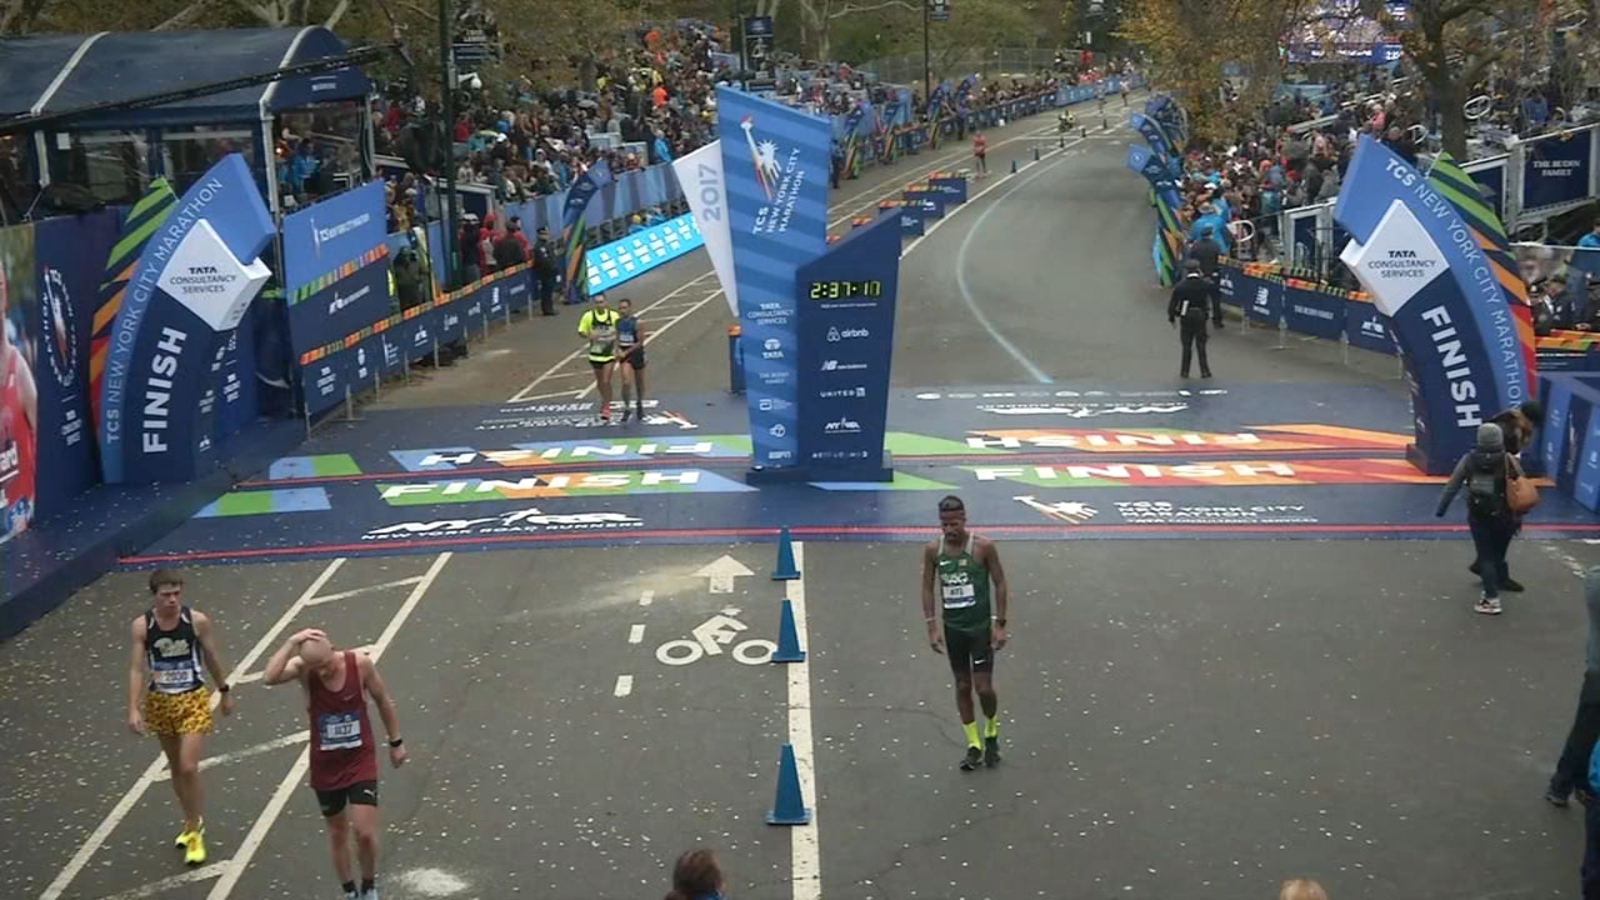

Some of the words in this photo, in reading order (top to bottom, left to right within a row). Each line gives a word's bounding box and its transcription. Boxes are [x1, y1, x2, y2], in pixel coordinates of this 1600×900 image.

[698, 163, 721, 223] 2017
[766, 207, 781, 233] NEW
[774, 175, 792, 208] YORK
[786, 148, 801, 174] CITY
[778, 170, 805, 232] MARATHON
[153, 177, 224, 262] MARATHON
[751, 207, 769, 235] TCS
[1368, 259, 1436, 269] CONSULTANCY
[1388, 250, 1417, 258] TATA
[133, 261, 158, 304] CITY
[169, 275, 236, 285] CONSULTANCY
[188, 266, 217, 275] TATA
[1381, 269, 1425, 278] SERVICES
[182, 285, 226, 294] SERVICES
[1384, 157, 1417, 188] TCS
[1413, 184, 1450, 219] NEW
[1446, 218, 1483, 267] YORK
[1474, 264, 1501, 304] CITY
[1491, 309, 1523, 411] MARATHON
[116, 309, 141, 360] YORK
[841, 328, 870, 338] airbnb
[761, 351, 784, 359] TATA
[1421, 304, 1483, 427] FINISH
[107, 362, 124, 404] NEW
[143, 327, 187, 453] FINISH
[820, 389, 855, 397] UNITED
[106, 408, 120, 443] TCS
[419, 441, 713, 466] FINISH
[964, 433, 1262, 450] FINISH
[379, 471, 701, 500] FINISH
[973, 463, 1295, 482] FINISH
[418, 529, 472, 537] YORK
[479, 525, 538, 533] ROAD
[546, 521, 645, 530] RUNNERS
